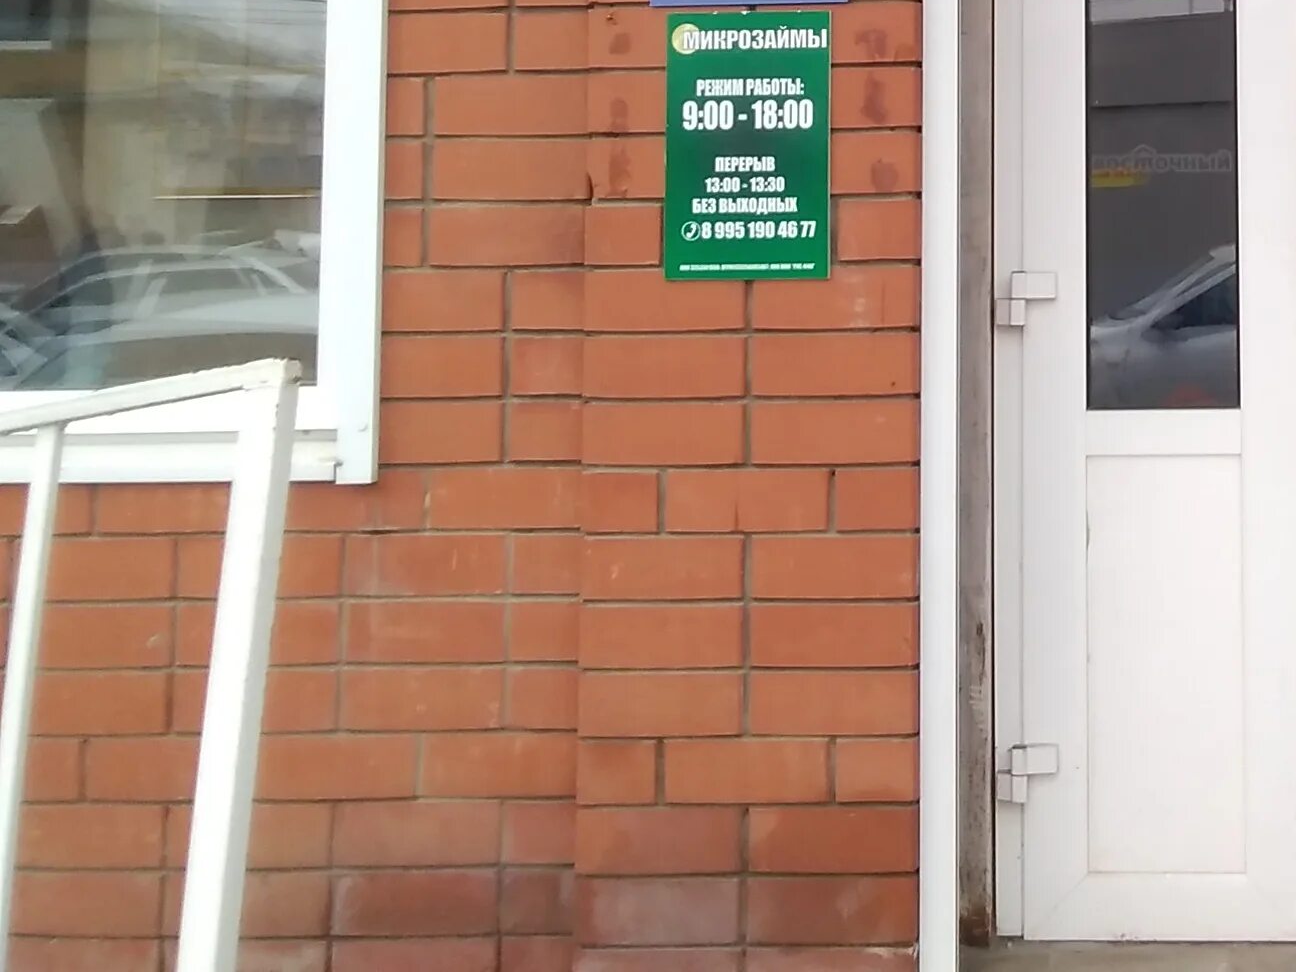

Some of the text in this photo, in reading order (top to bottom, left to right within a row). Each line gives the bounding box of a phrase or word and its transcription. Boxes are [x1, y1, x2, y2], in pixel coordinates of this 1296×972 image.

[683, 25, 828, 50] МИКРОЗАЙМЫ
[696, 78, 805, 96] РЕЖИМ РАБОТЫ:
[682, 100, 735, 130] 9:00
[751, 98, 814, 130] 18:00
[714, 156, 776, 172] ПЕРЕРЫВ
[705, 177, 741, 193] 13:00
[749, 176, 786, 192] 13:30
[691, 197, 798, 215] БЕЗ ВЫХОДНЫХ
[701, 220, 816, 239] 8 995 190 46 77
